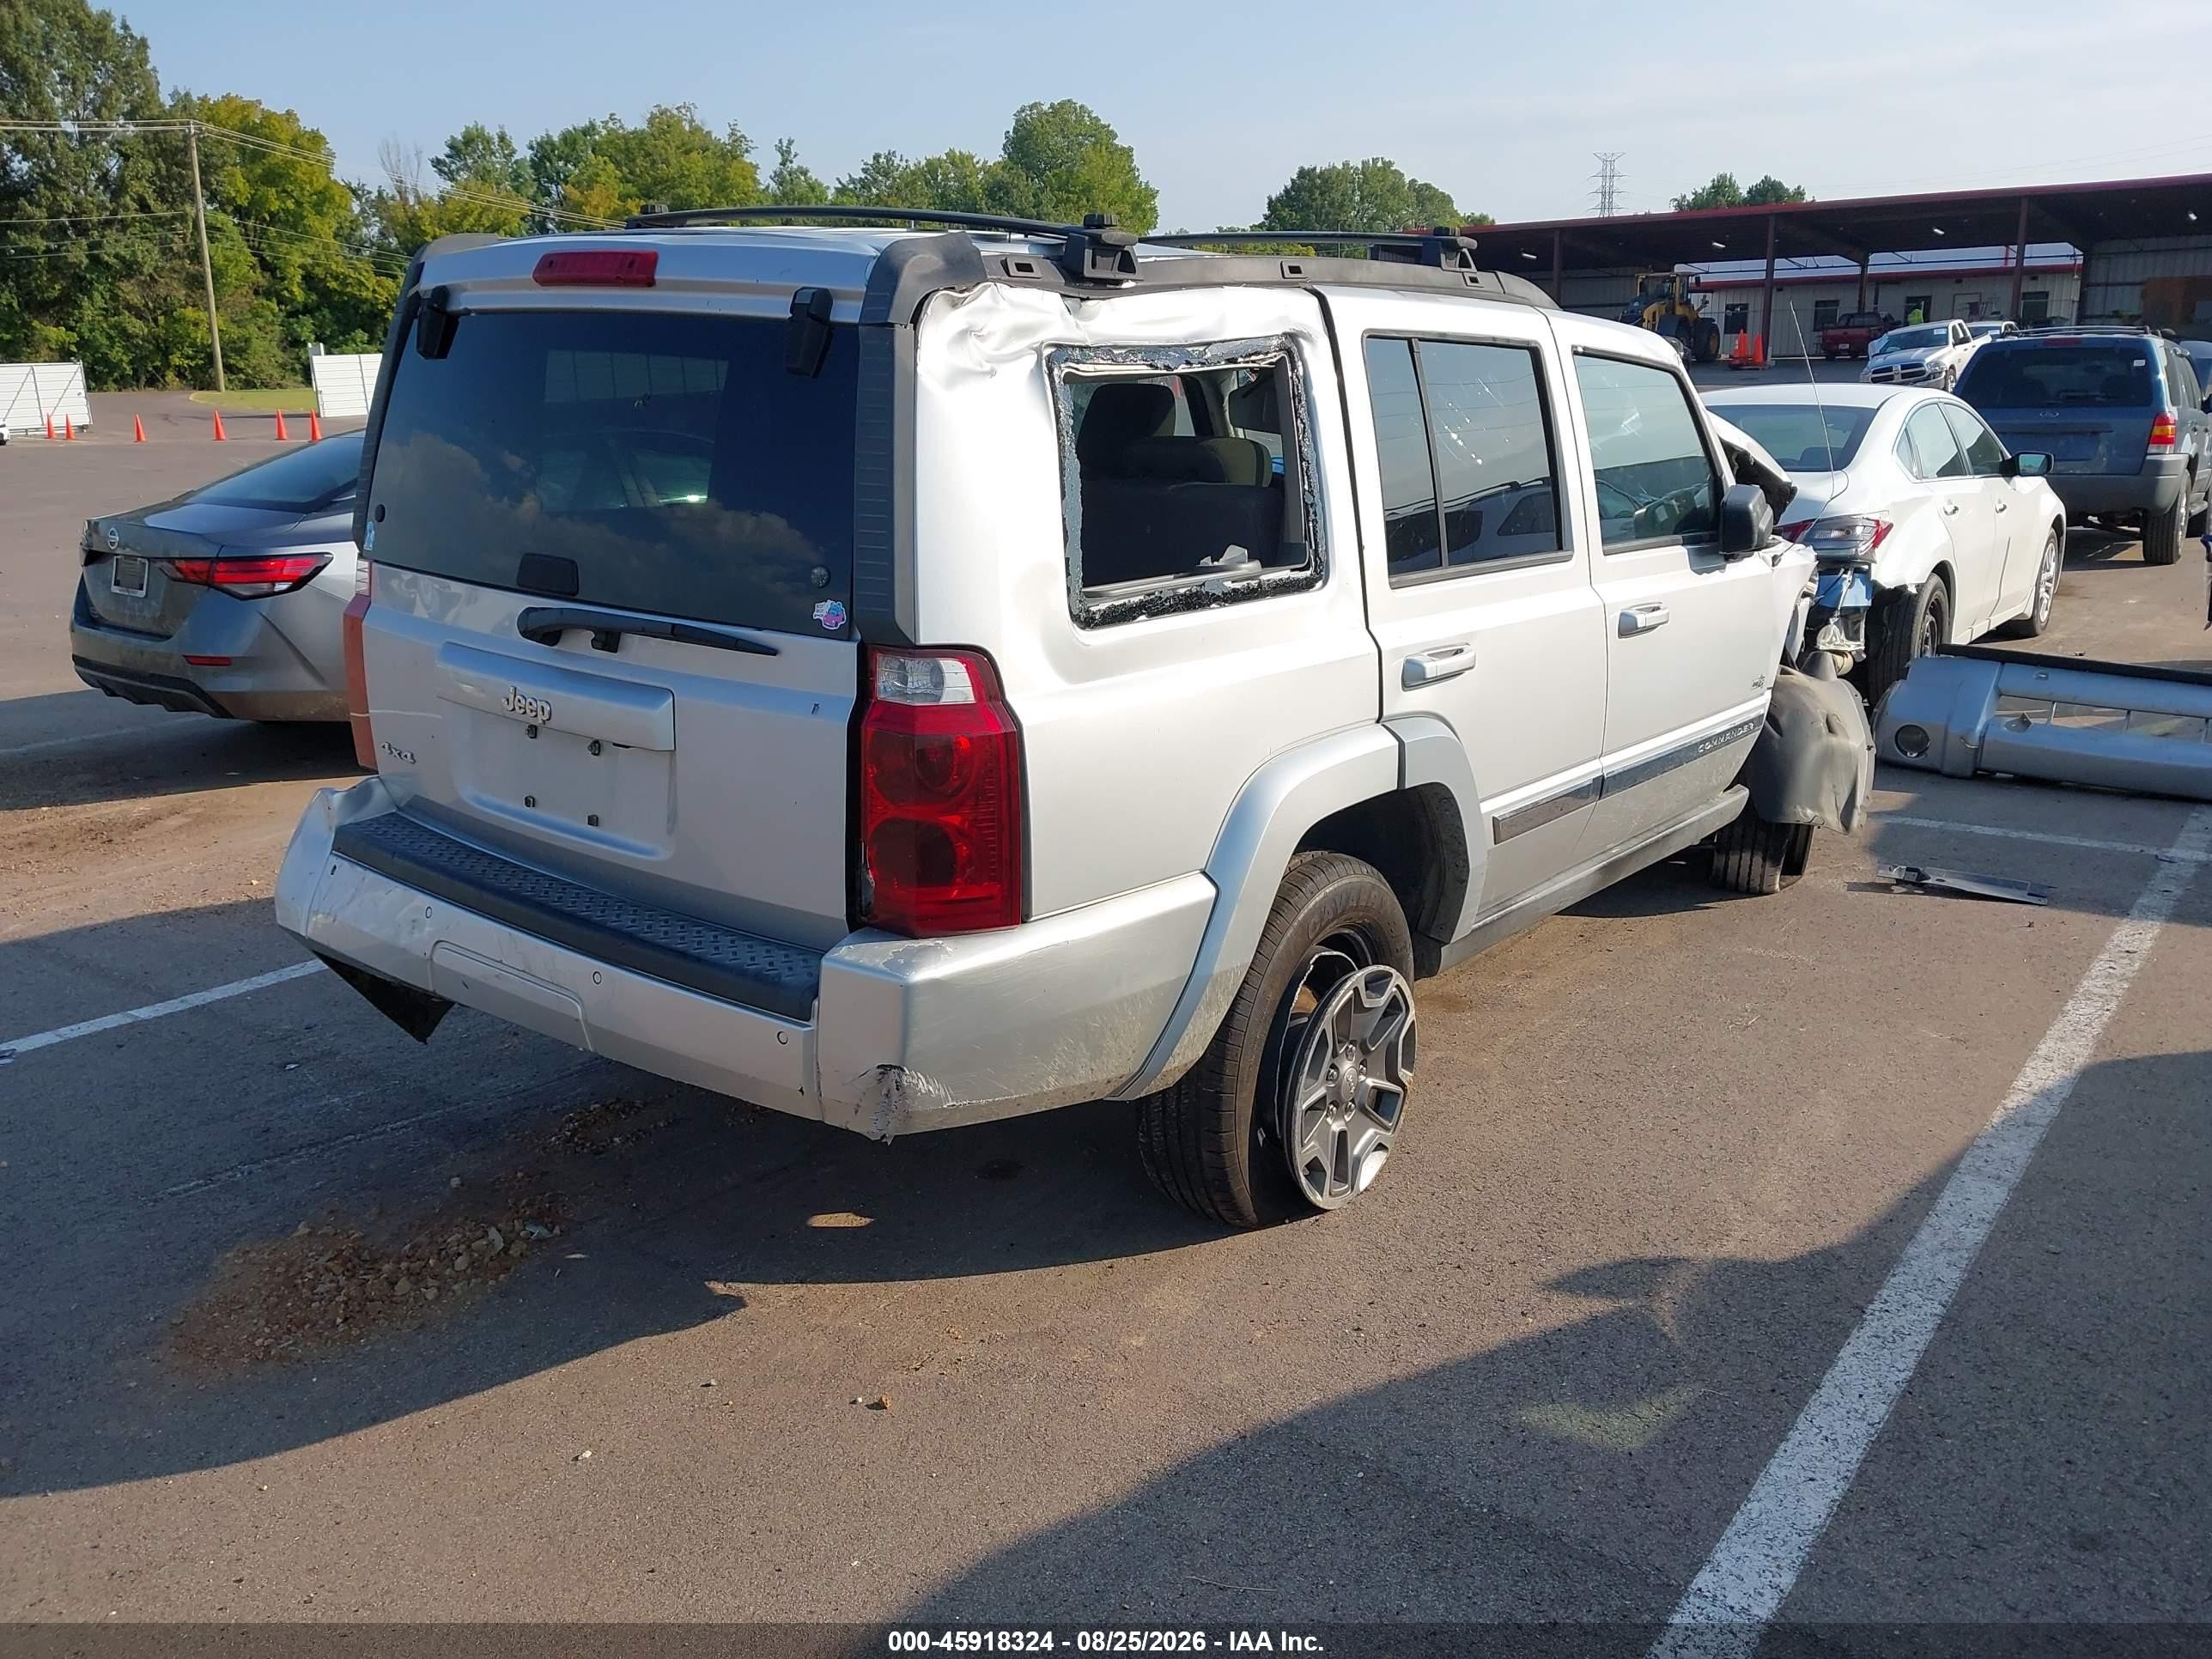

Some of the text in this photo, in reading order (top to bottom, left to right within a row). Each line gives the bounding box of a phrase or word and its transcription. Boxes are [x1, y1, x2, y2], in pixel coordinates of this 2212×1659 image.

[501, 686, 551, 723] Jeep
[1698, 722, 1754, 752] COMMANDER
[380, 741, 416, 764] 4x4
